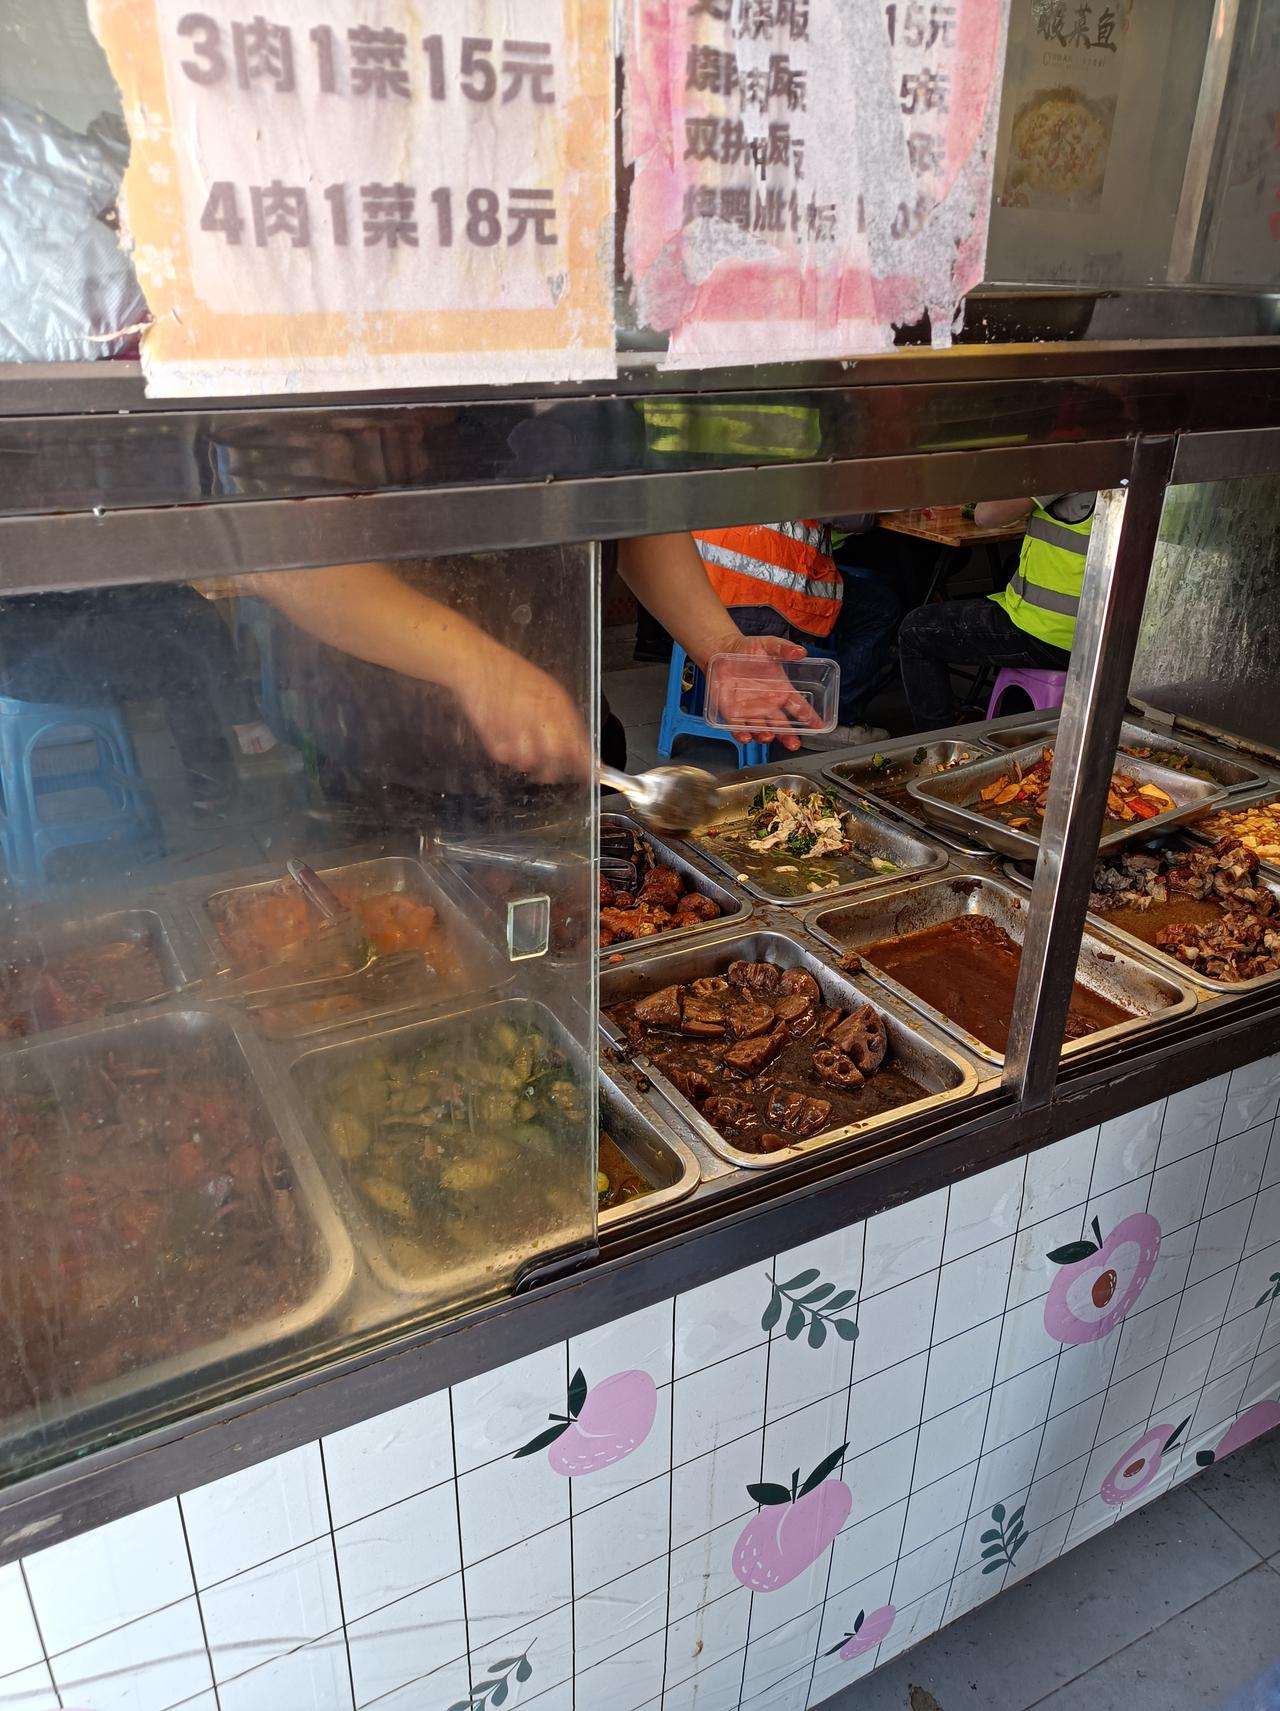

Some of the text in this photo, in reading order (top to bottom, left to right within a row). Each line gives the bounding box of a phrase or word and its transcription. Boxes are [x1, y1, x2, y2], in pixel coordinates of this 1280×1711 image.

[177, 12, 557, 105] 3肉1菜15元
[199, 177, 558, 249] 4肉1菜18元
